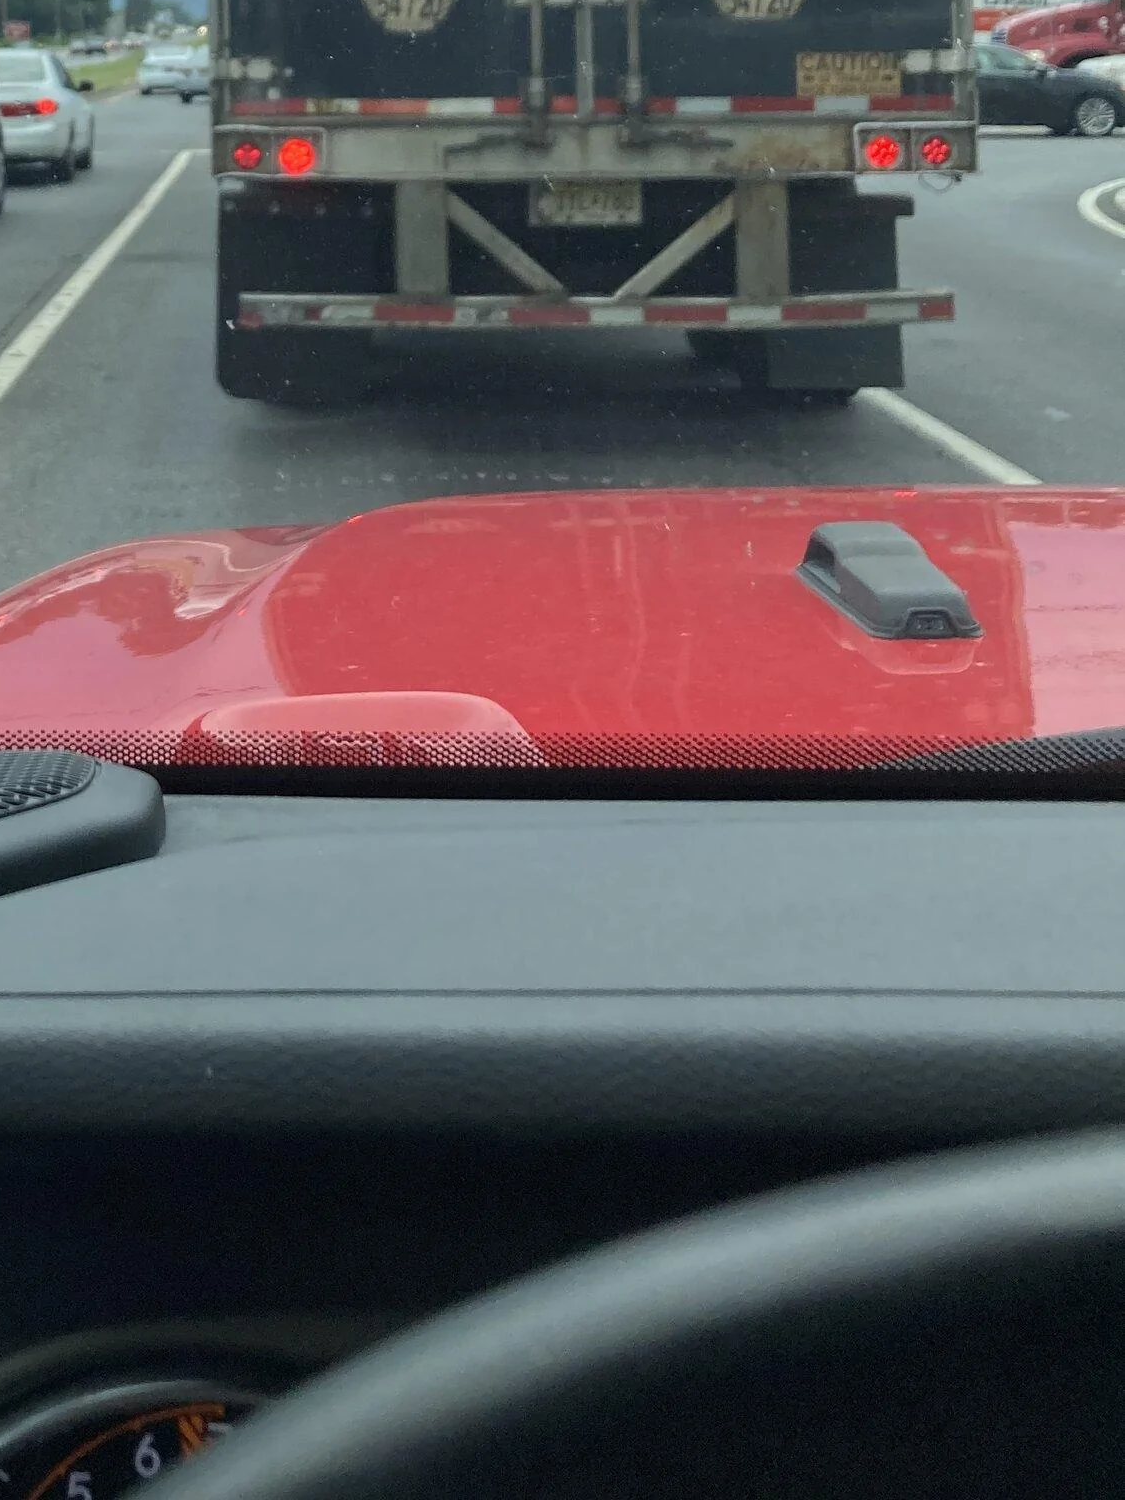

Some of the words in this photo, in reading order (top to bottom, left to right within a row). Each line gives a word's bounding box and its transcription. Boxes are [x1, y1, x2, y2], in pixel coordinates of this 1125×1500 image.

[800, 51, 898, 71] CAUTION
[134, 1432, 161, 1479] 6
[67, 1471, 93, 1500] 5
